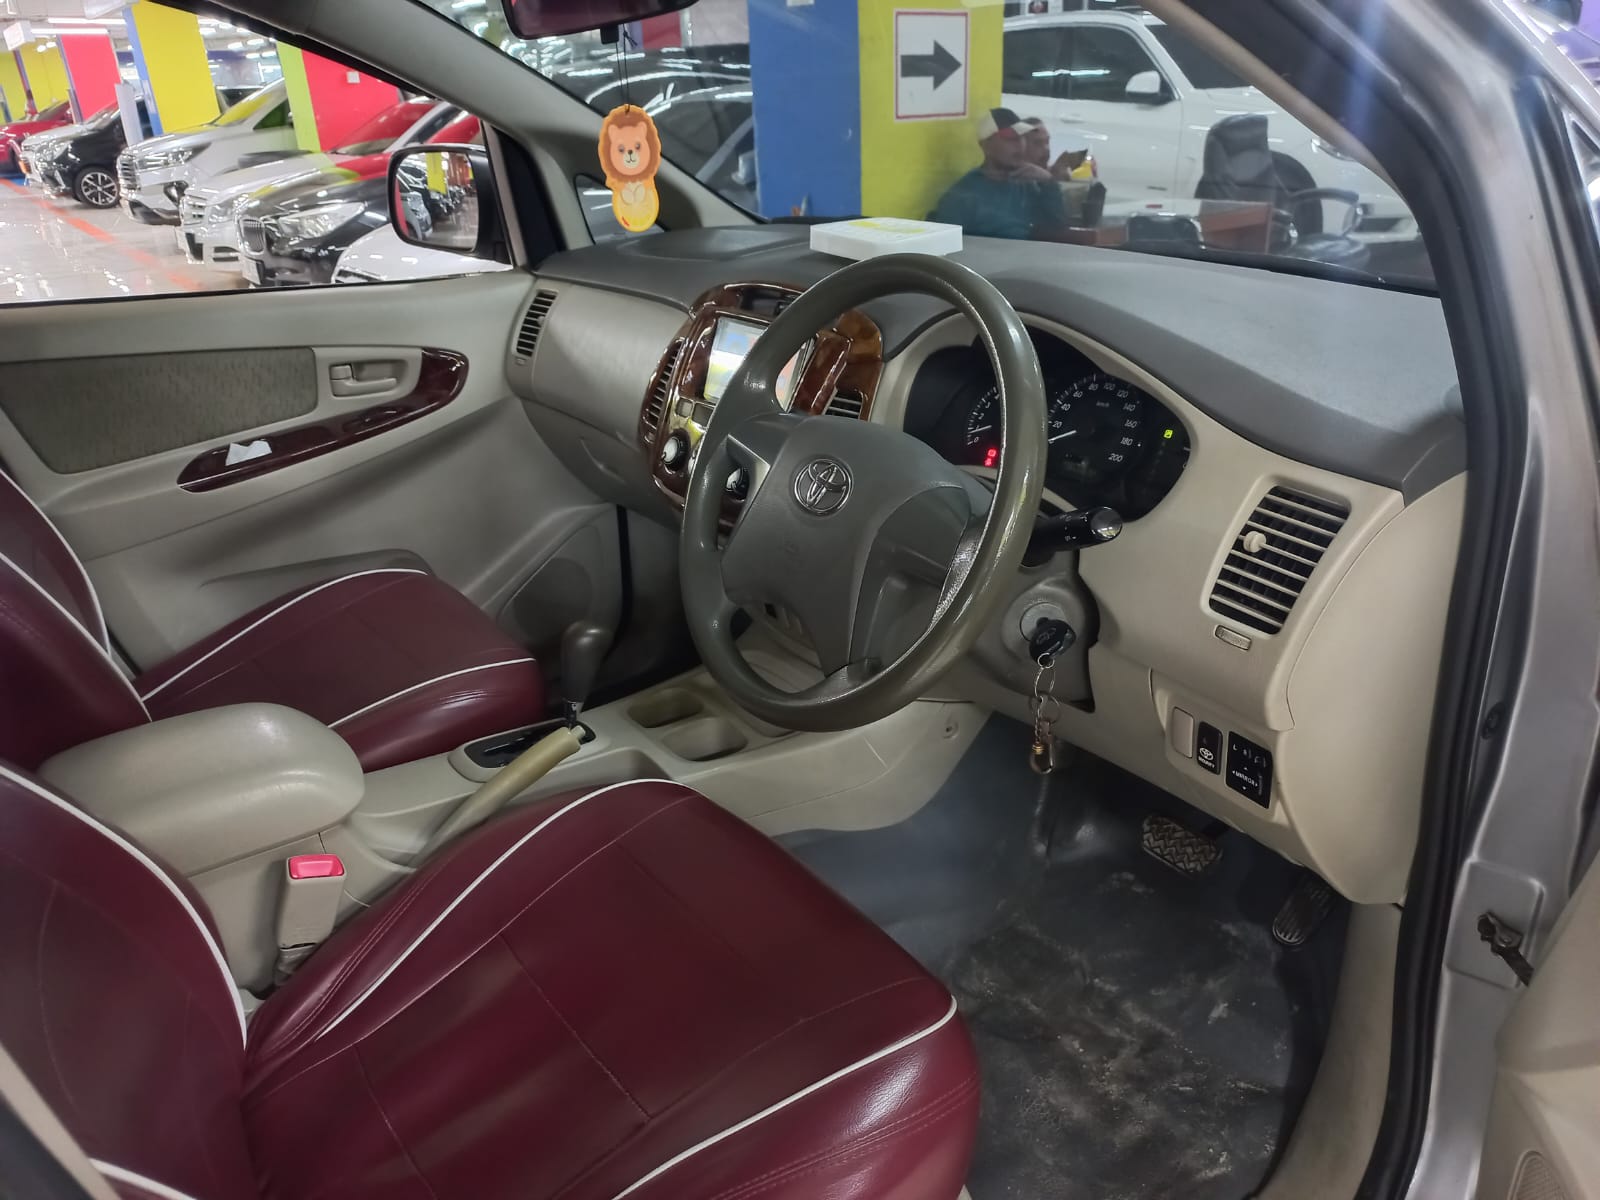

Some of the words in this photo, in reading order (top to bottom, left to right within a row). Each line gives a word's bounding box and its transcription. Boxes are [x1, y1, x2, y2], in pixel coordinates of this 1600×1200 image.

[1060, 403, 1071, 411] 40
[1122, 402, 1136, 412] 140
[1052, 420, 1063, 429] 20
[1124, 419, 1138, 429] 160
[1120, 436, 1134, 446] 180
[1108, 453, 1124, 462] 200
